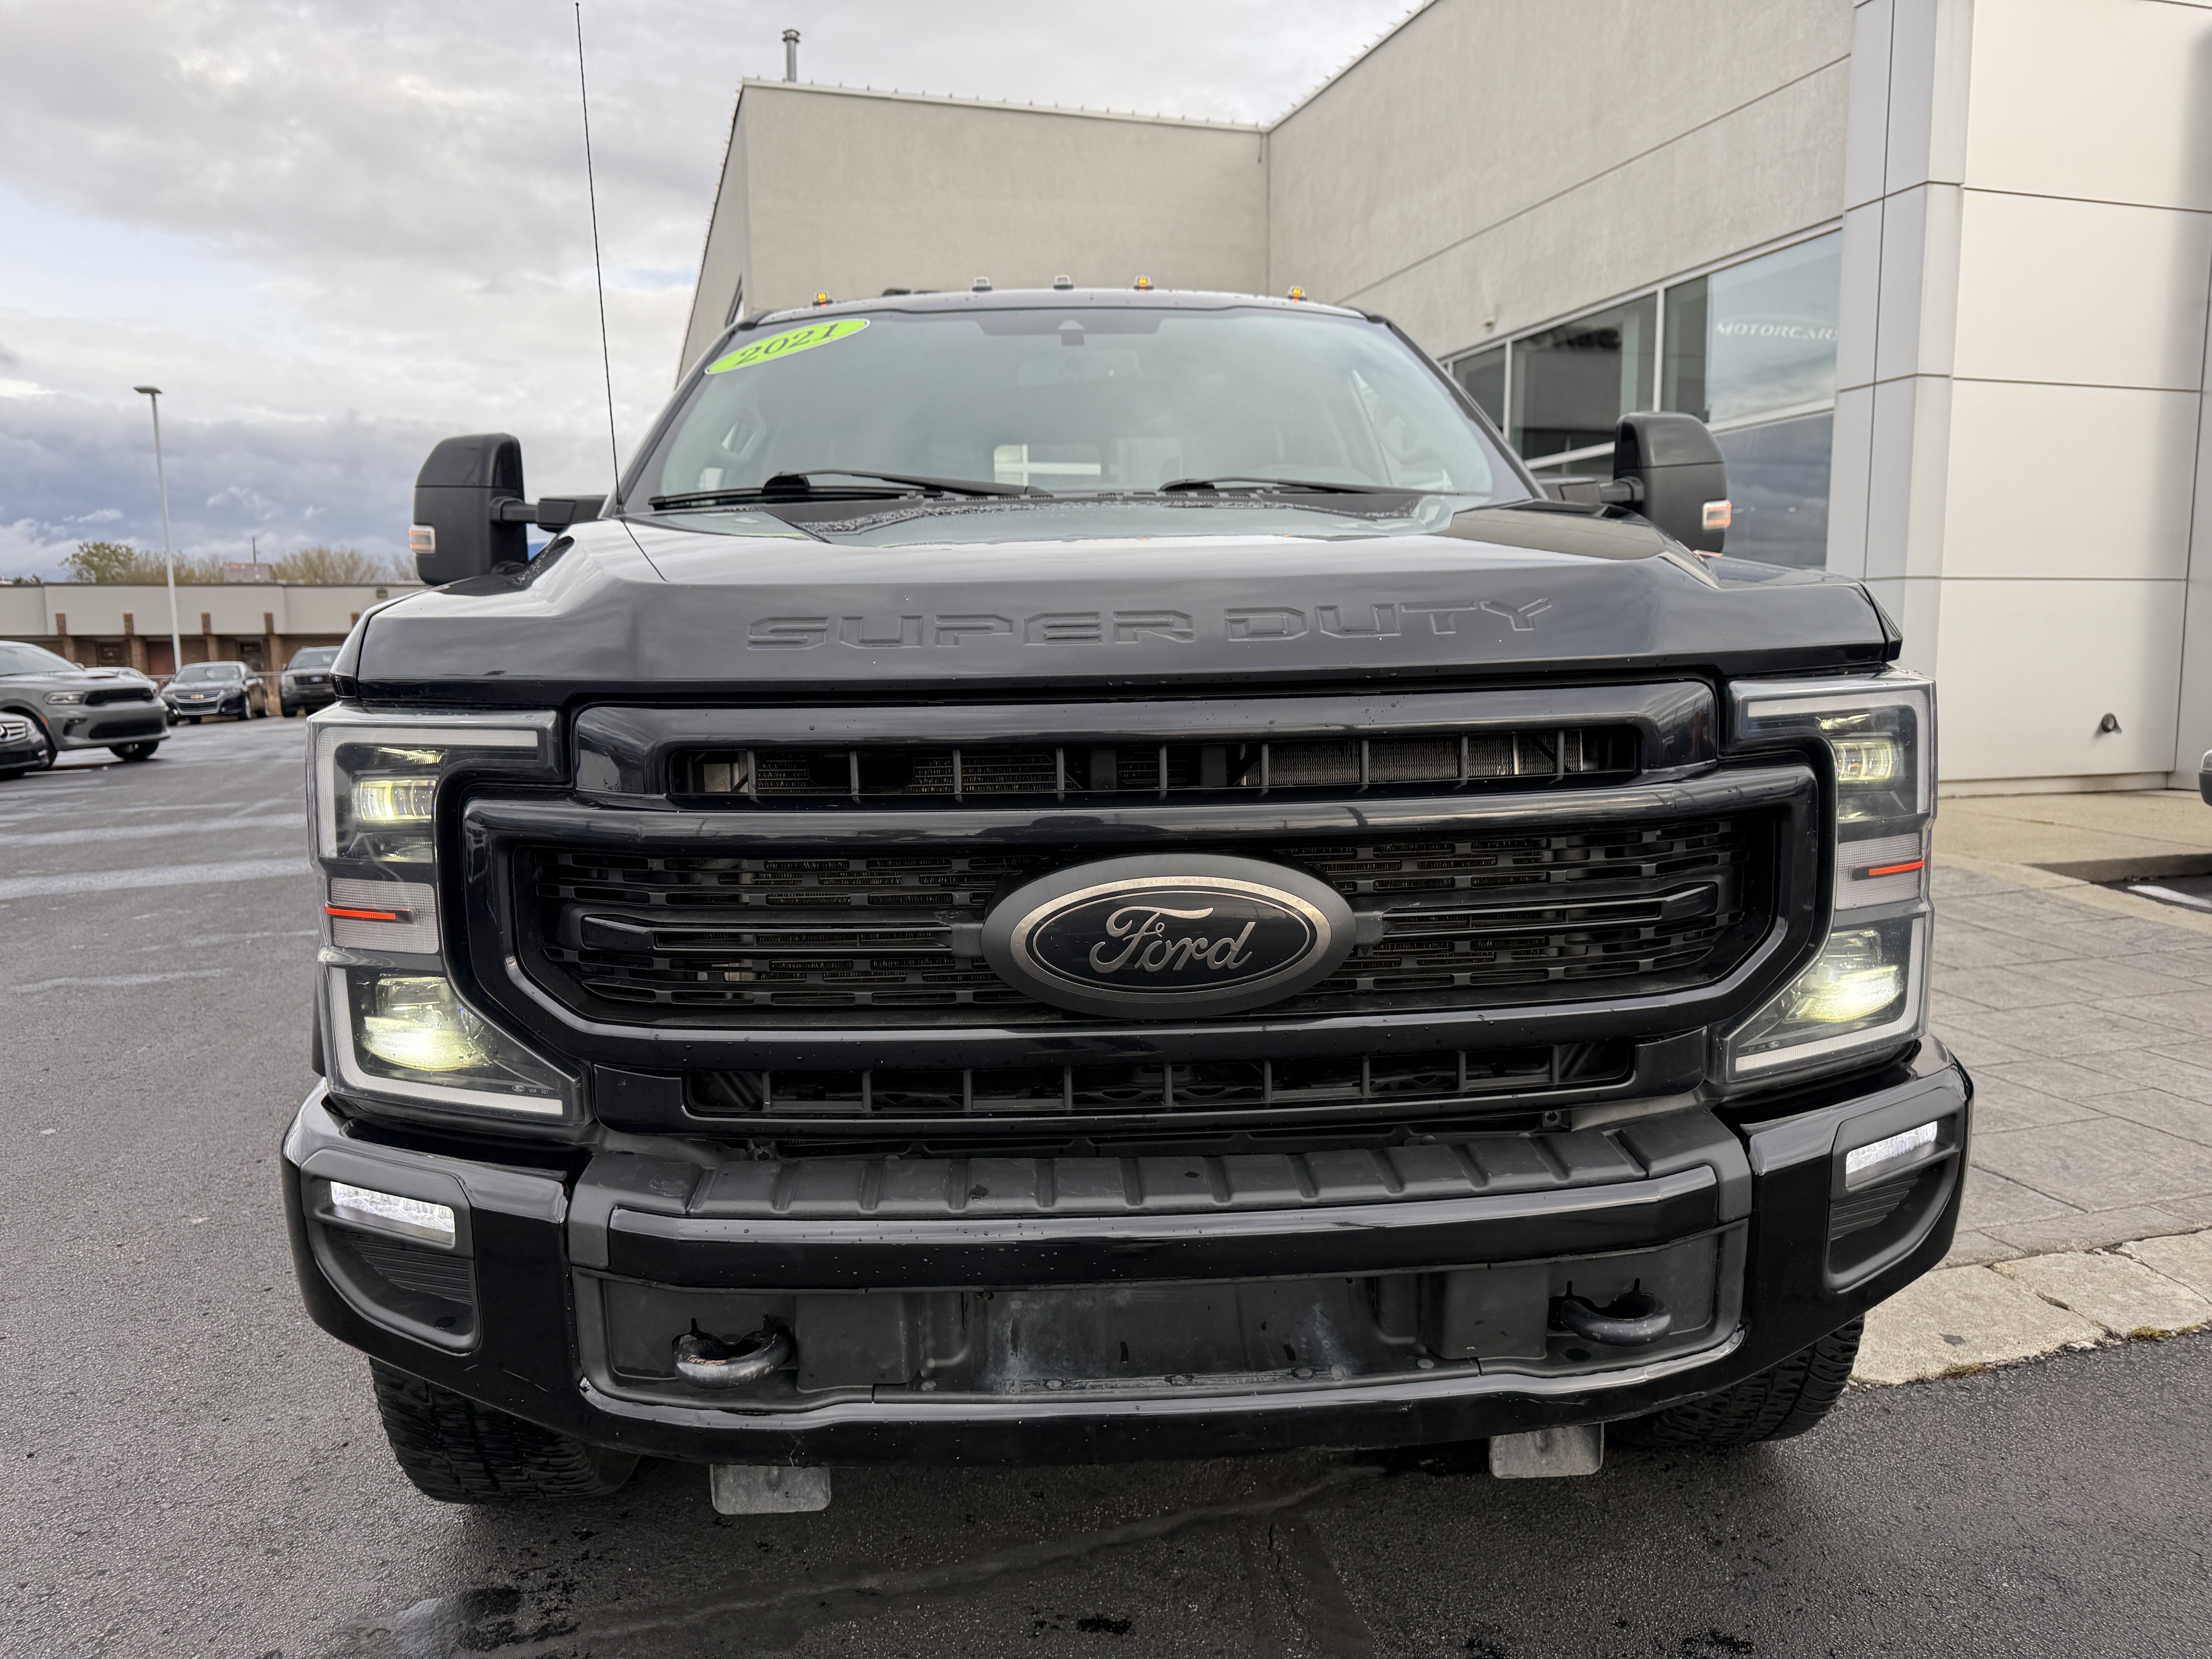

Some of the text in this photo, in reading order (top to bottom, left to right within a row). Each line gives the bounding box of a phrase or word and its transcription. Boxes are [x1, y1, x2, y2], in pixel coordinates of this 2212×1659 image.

[734, 323, 839, 367] 2021
[747, 598, 1553, 650] SUPER DUTY
[1089, 906, 1256, 974] Ford
